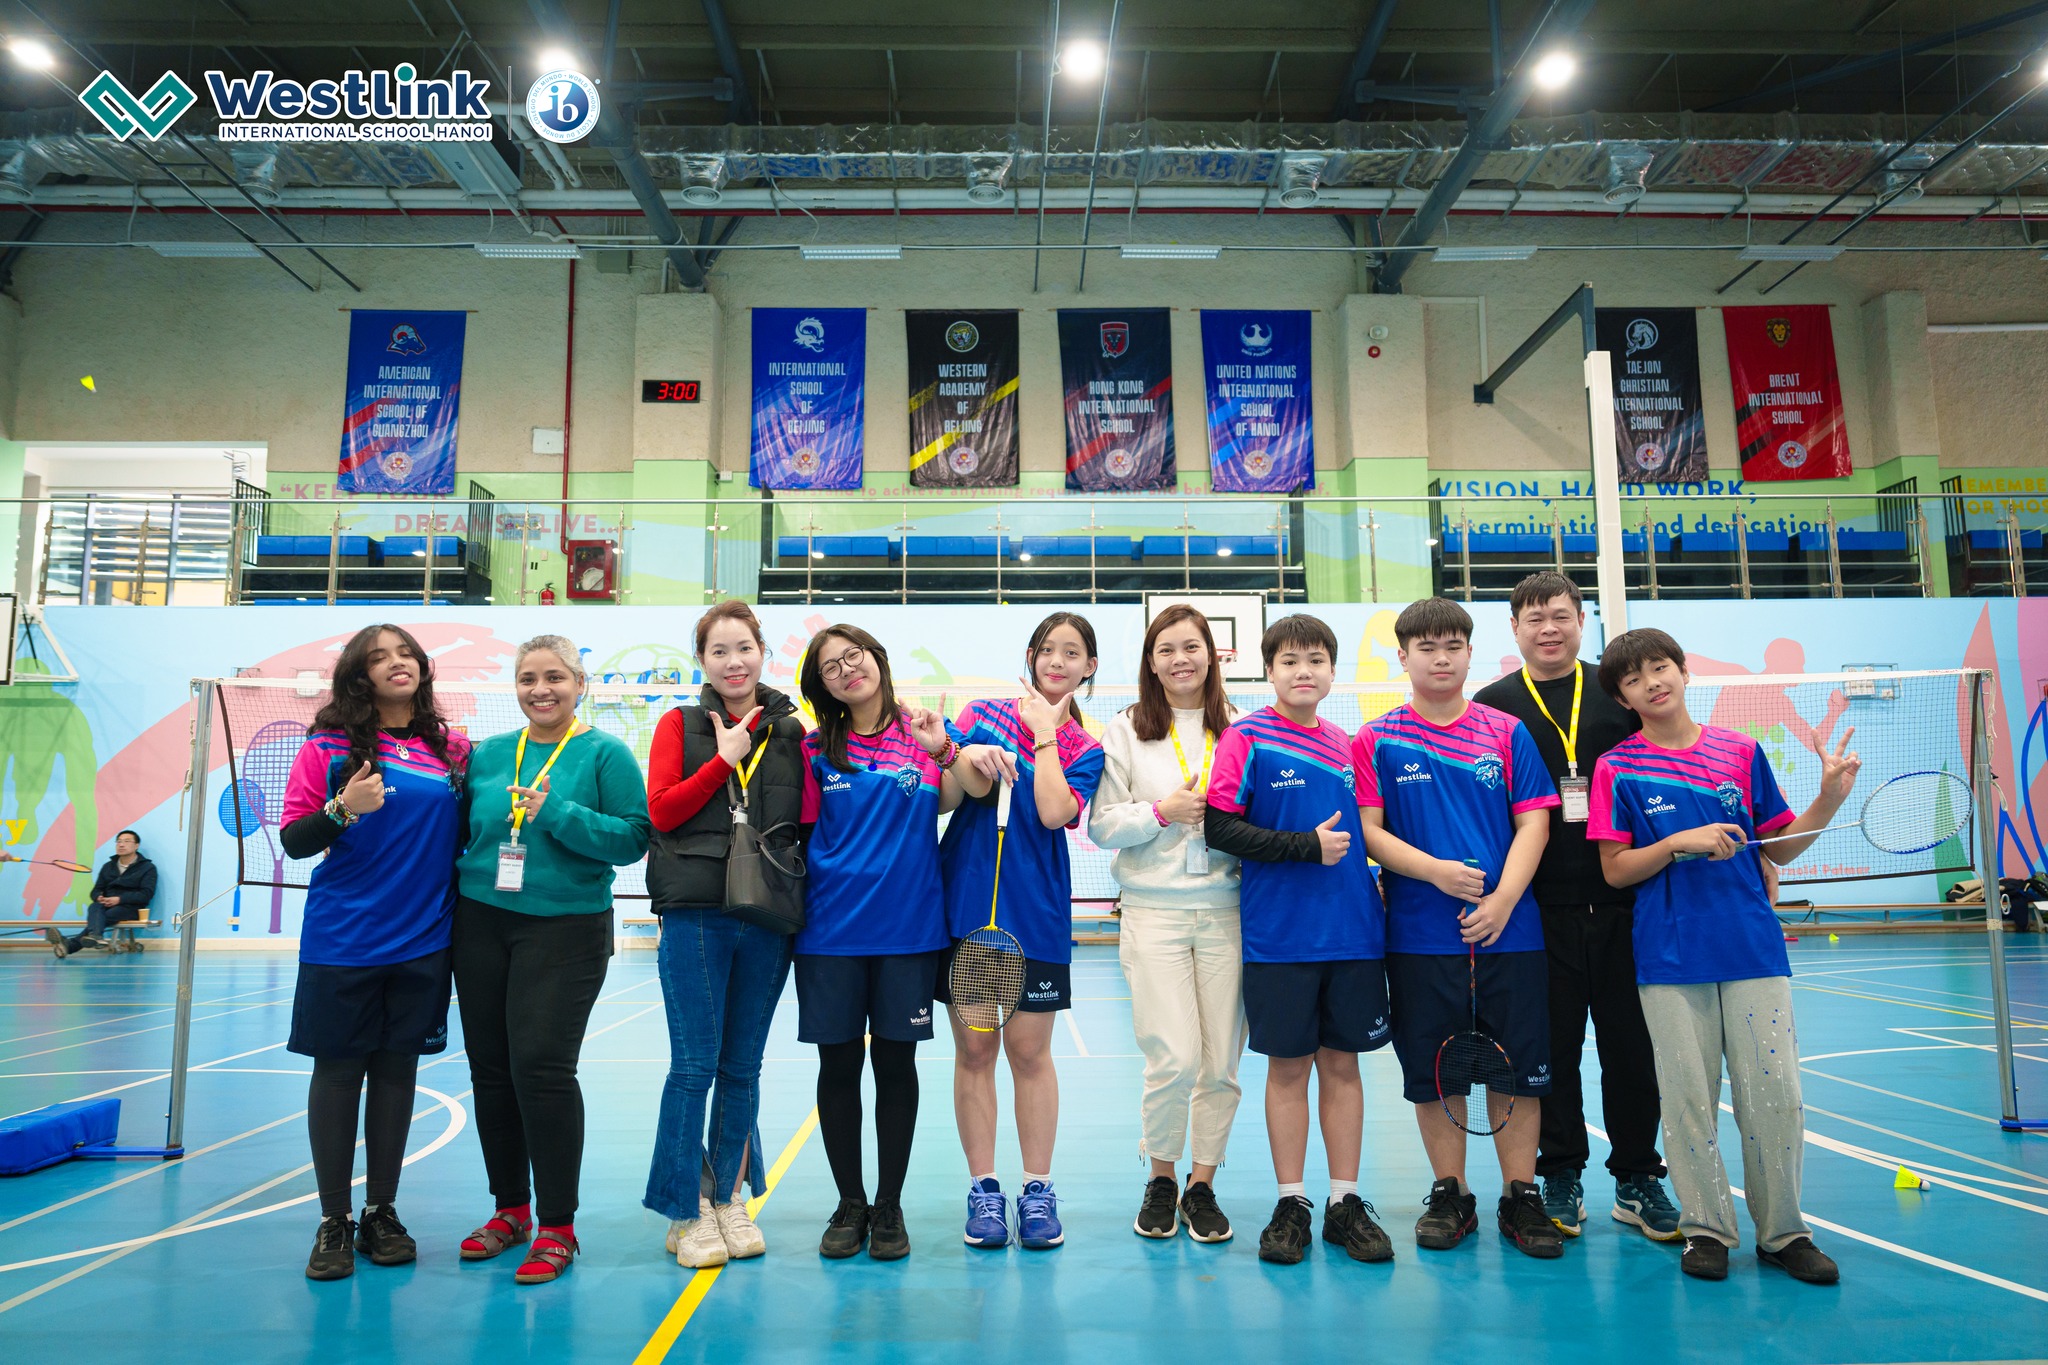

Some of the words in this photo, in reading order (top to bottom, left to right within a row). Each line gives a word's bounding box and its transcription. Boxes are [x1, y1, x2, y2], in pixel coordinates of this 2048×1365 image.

[378, 365, 431, 380] AMERICAN
[768, 362, 847, 376] INTERNATIONAL
[938, 363, 987, 378] WESTERN
[1216, 364, 1252, 379] UNITED
[1255, 364, 1297, 379] NATIONS
[1625, 360, 1662, 375] TAEJON
[1088, 380, 1115, 395] HONG
[1118, 379, 1144, 394] KONG
[1620, 378, 1670, 393] CHRISTIAN
[1769, 372, 1801, 388] BRENT
[363, 384, 442, 399] INTERNATIONAL
[657, 381, 698, 401] 3:00
[790, 381, 825, 396] SCHOOL
[939, 382, 986, 396] ACADEMY
[1218, 383, 1295, 398] INTERNATIONAL
[1613, 396, 1685, 412] NTERNATIONAL
[1748, 389, 1824, 408] INTERNATIONAL
[376, 404, 411, 418] SCHOOL
[415, 404, 428, 419] OF
[800, 400, 813, 414] OF
[956, 401, 969, 415] OF
[1078, 398, 1156, 415] INTERNATIONAL
[1240, 403, 1275, 417] SCHOOL
[1630, 415, 1665, 431] SCHOOL
[1772, 410, 1805, 426] SCHOOL
[372, 424, 429, 438] GUANGZHOU
[787, 419, 826, 434] BEIJING
[944, 419, 983, 434] BEIJING
[1100, 418, 1136, 434] SCHOOL
[1235, 422, 1248, 437] OF
[1250, 422, 1281, 437] HANOI
[1656, 480, 1757, 504] WORK,
[1270, 777, 1306, 789] Westlink
[1395, 771, 1433, 784] Westlink
[1821, 862, 1870, 876] Palmer
[1027, 990, 1060, 999] Westlink
